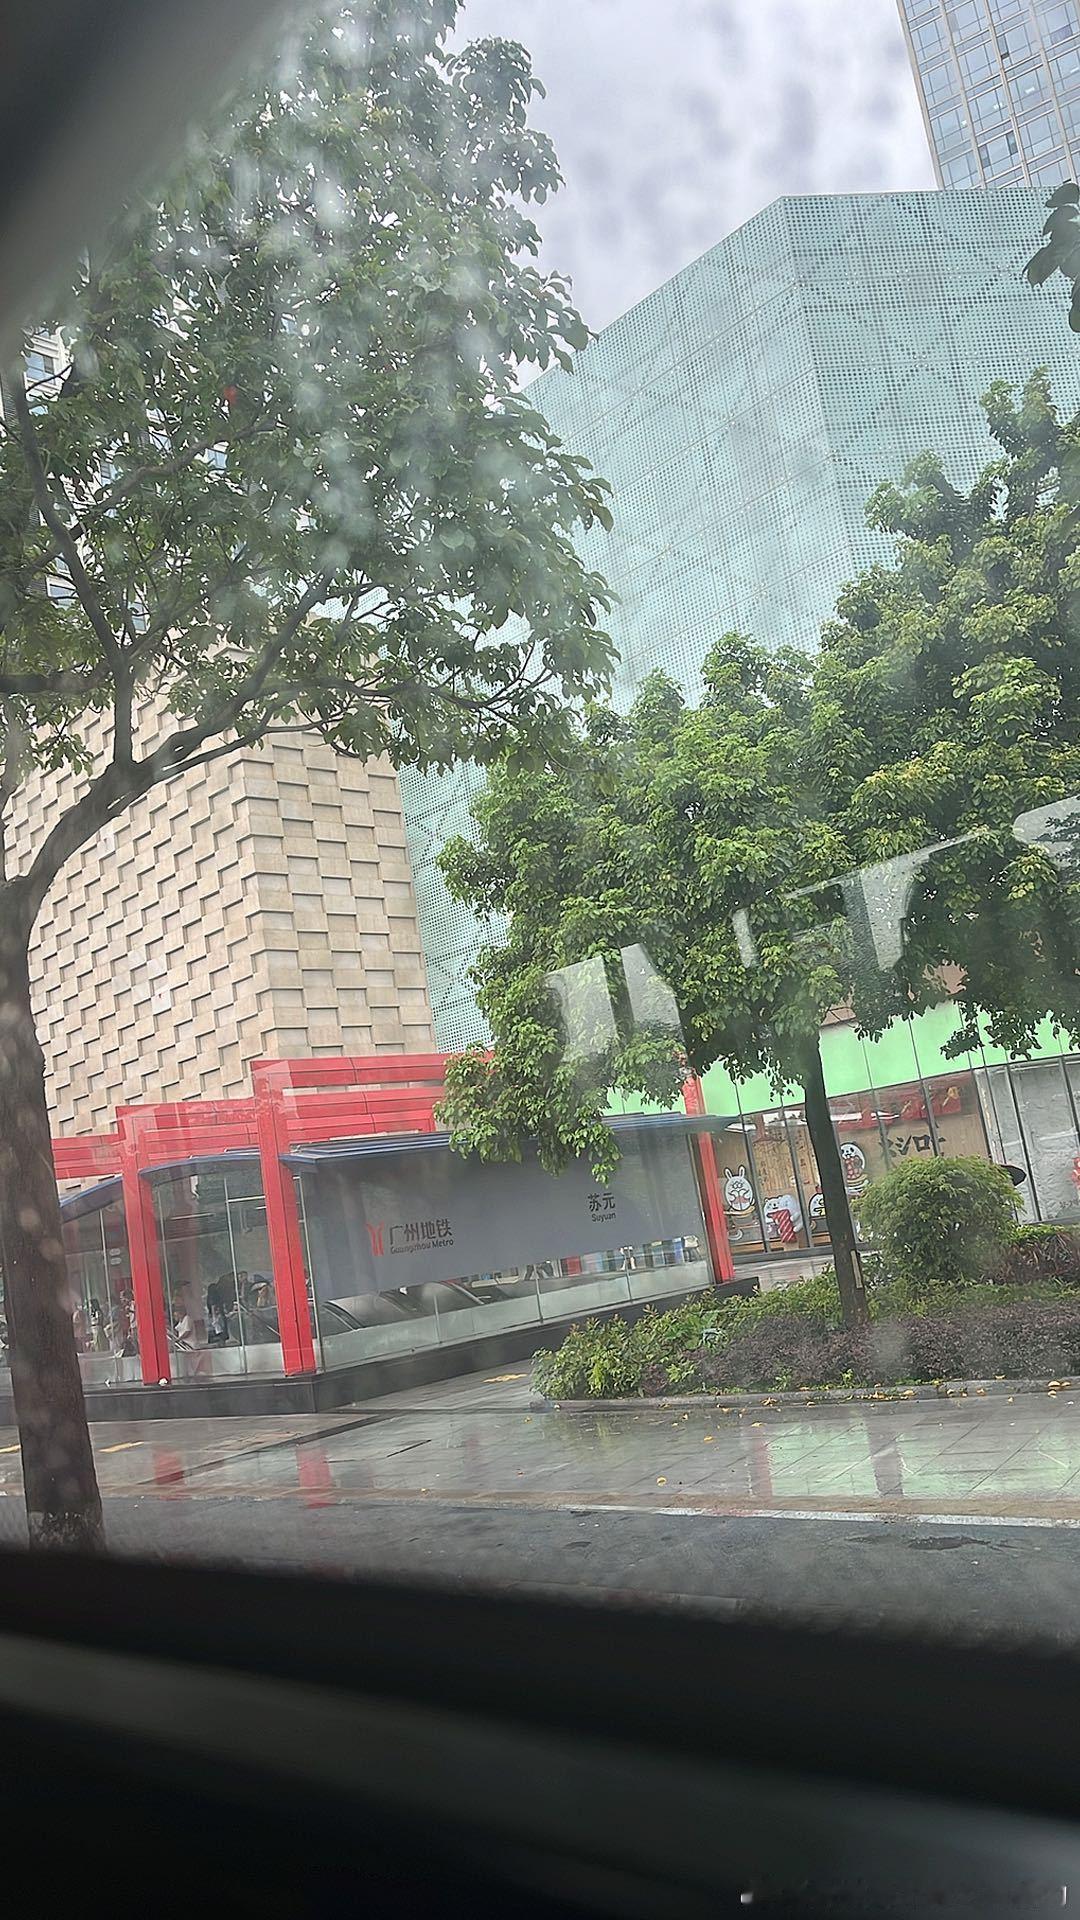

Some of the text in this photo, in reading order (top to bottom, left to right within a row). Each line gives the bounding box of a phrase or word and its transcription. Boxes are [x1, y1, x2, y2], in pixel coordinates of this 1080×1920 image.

[588, 1192, 615, 1211] 苏元
[592, 1212, 616, 1223] Suyuan
[390, 1218, 452, 1245] 广州地铁
[391, 1239, 454, 1254] Guangzhou Metro
